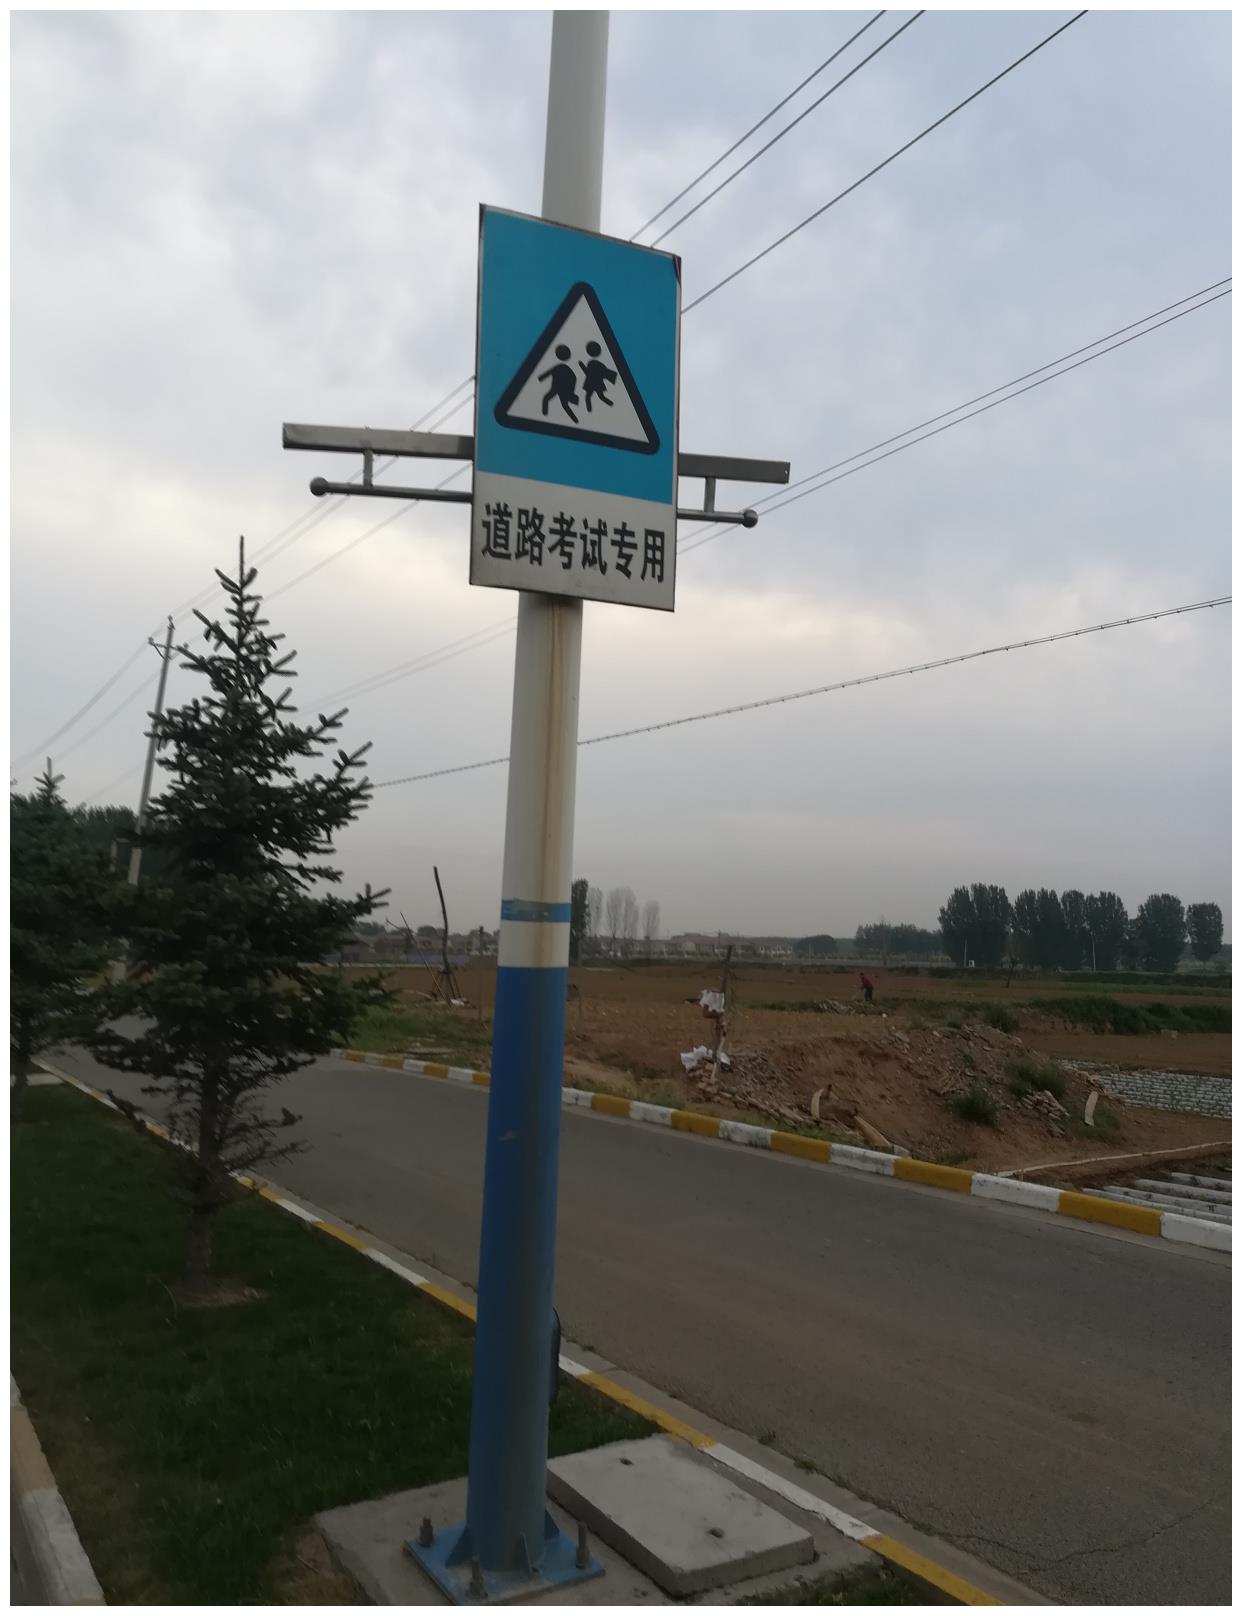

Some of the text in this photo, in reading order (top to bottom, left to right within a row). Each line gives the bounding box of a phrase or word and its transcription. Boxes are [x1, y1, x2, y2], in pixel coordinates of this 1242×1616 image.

[481, 502, 665, 583] 道路考试专用
